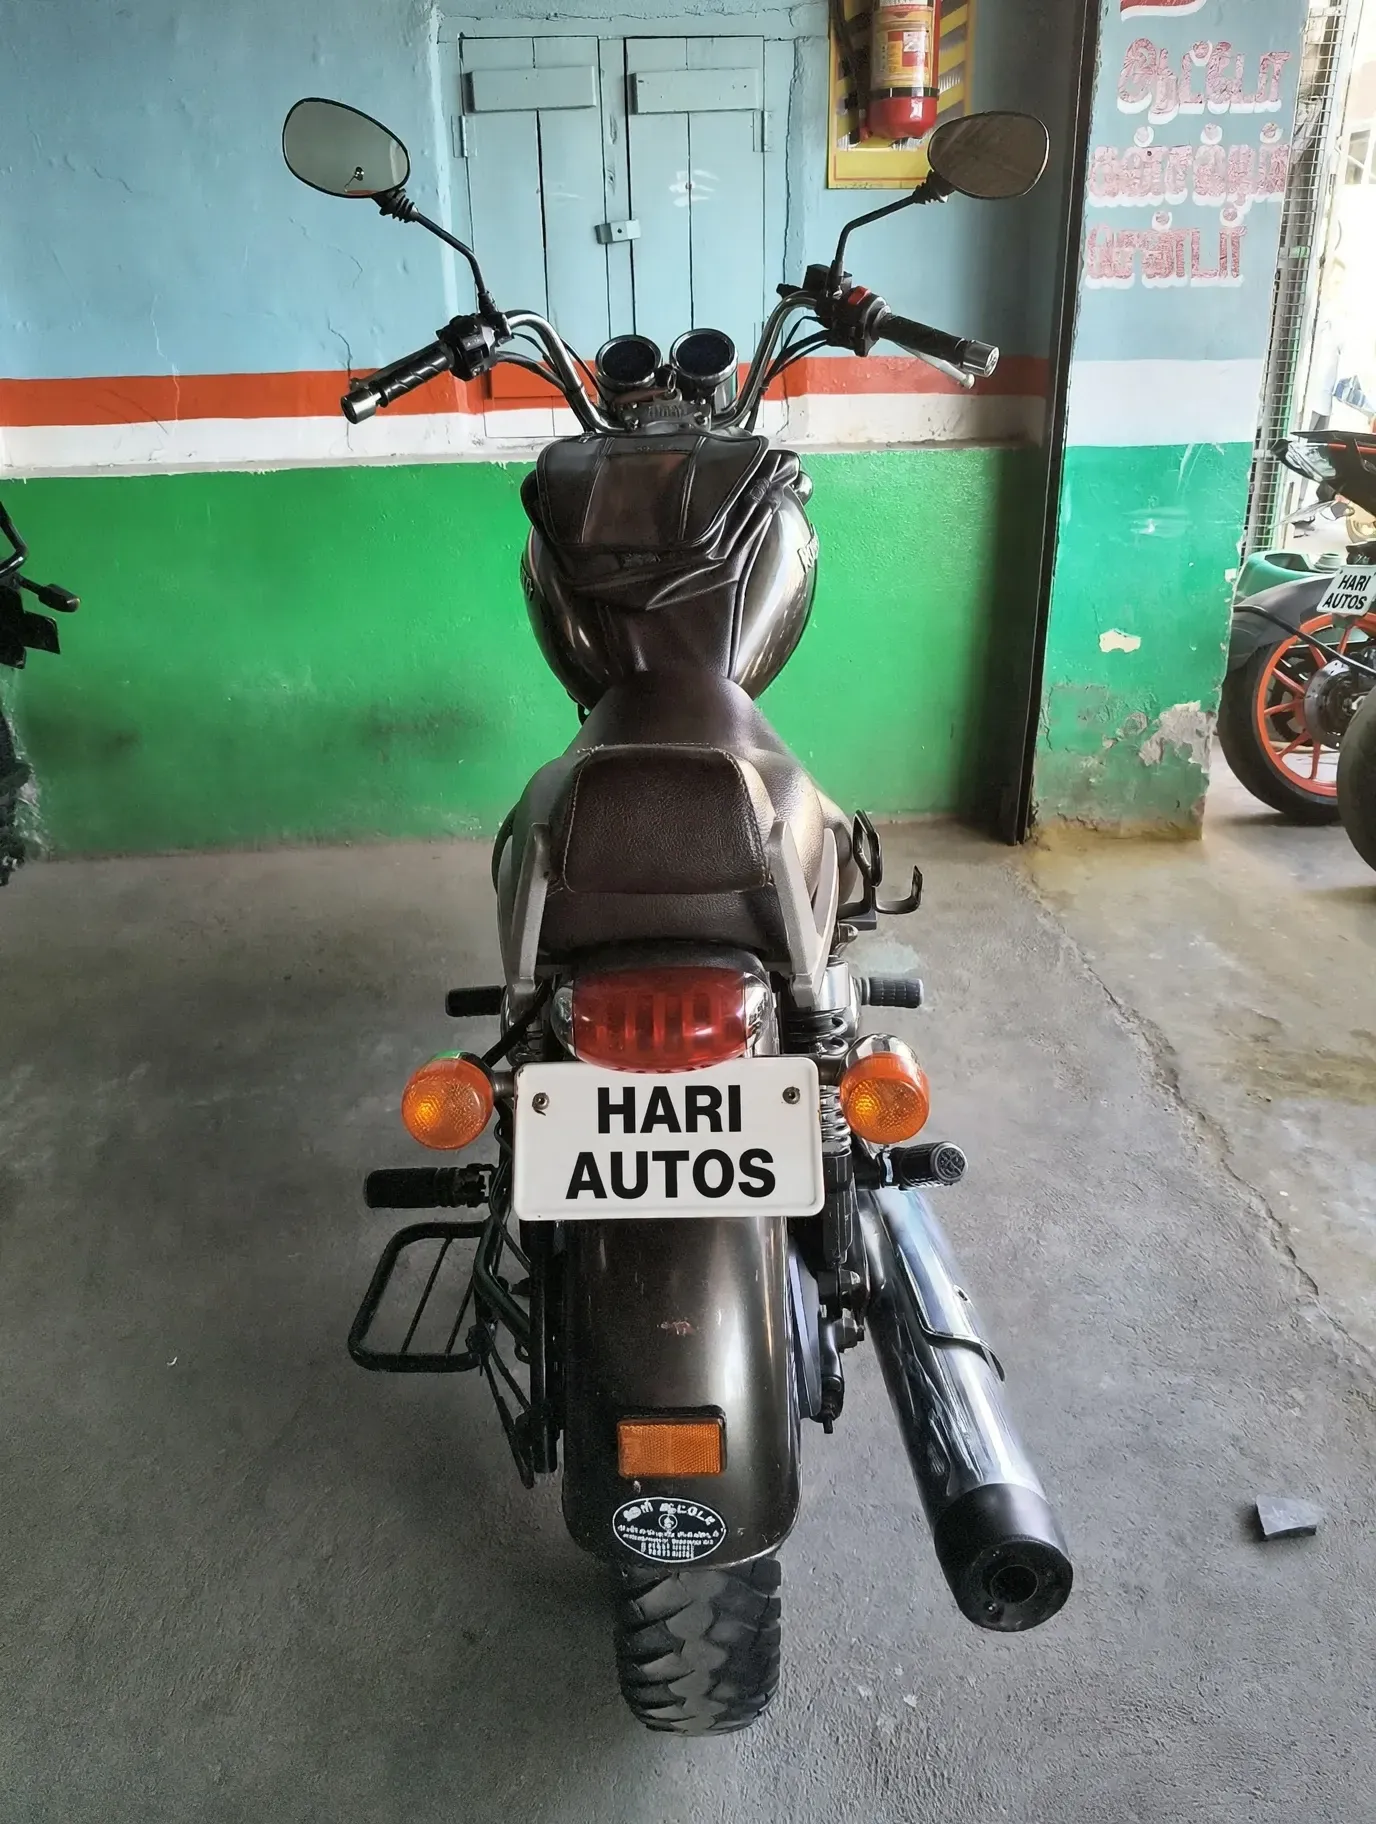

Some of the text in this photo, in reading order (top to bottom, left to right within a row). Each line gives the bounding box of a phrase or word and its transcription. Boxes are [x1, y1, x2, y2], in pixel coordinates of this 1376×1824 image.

[1338, 574, 1371, 591] HARI
[1322, 593, 1367, 609] AUTOS
[597, 1085, 742, 1134] HARI
[565, 1148, 776, 1199] AUTOS
